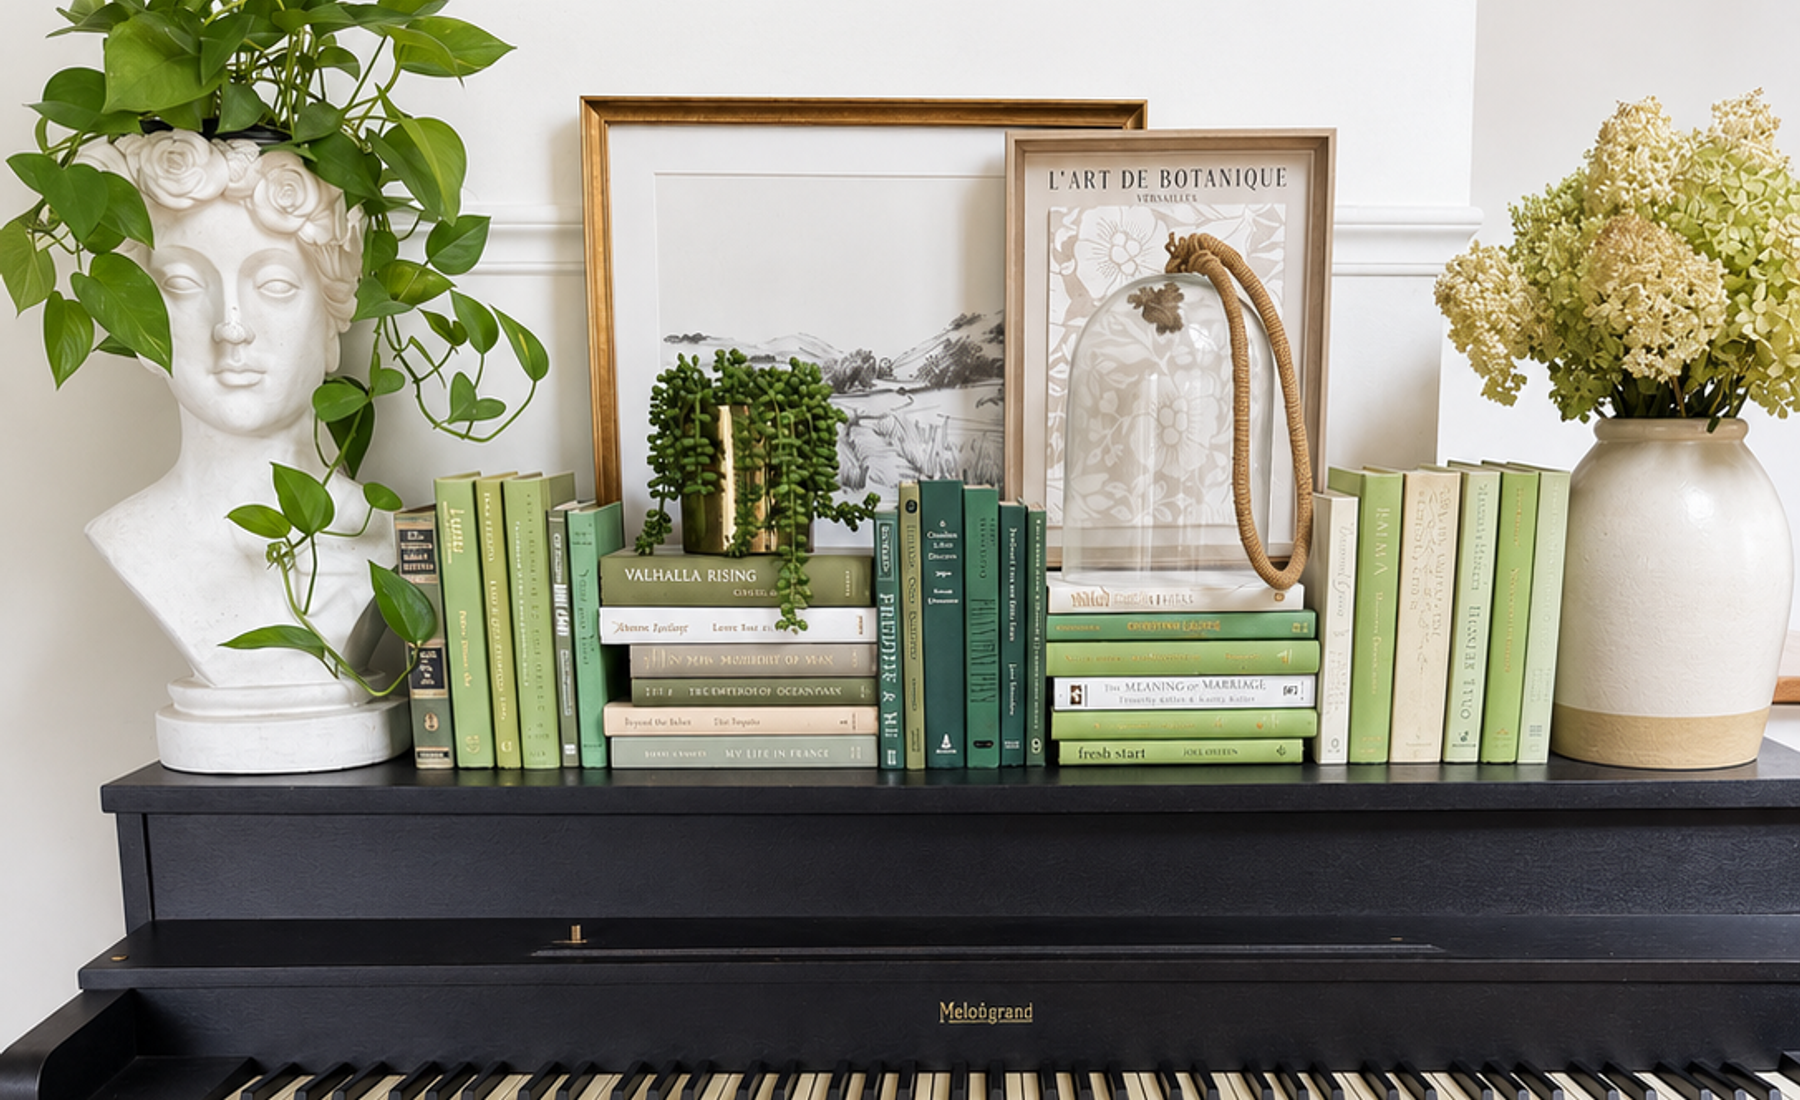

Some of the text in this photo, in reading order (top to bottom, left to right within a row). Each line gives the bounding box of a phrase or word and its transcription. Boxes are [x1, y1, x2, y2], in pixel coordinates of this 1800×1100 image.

[1049, 167, 1288, 191] L'ART DE BOTANIQUE
[624, 568, 757, 582] VALHALLA RISING
[1125, 681, 1185, 693] MEANING
[1201, 678, 1267, 691] MARRIAGE
[789, 748, 830, 758] FRANCE
[1078, 746, 1146, 760] fresh start
